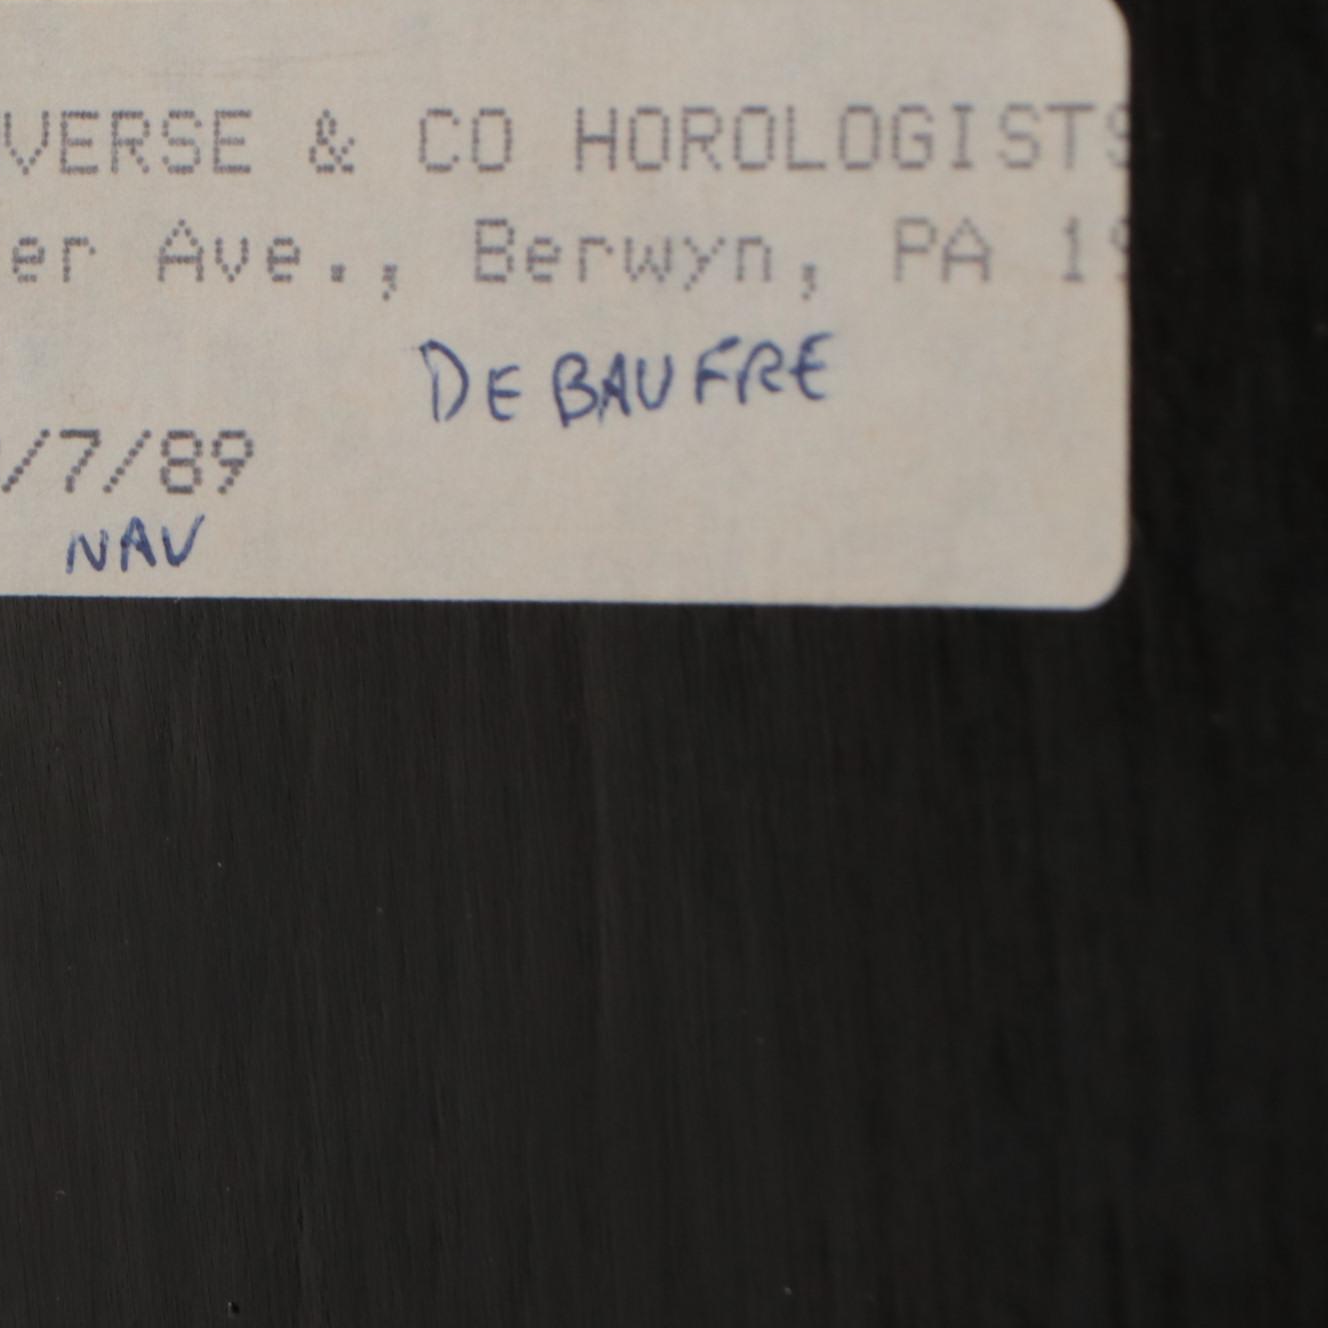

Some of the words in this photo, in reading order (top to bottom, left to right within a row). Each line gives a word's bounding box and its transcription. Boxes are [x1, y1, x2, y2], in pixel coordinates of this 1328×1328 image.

[309, 109, 355, 174] &
[419, 108, 513, 174] CO
[157, 219, 398, 301] Ave.,
[475, 218, 816, 300] Berwyn,
[895, 218, 991, 281] PA
